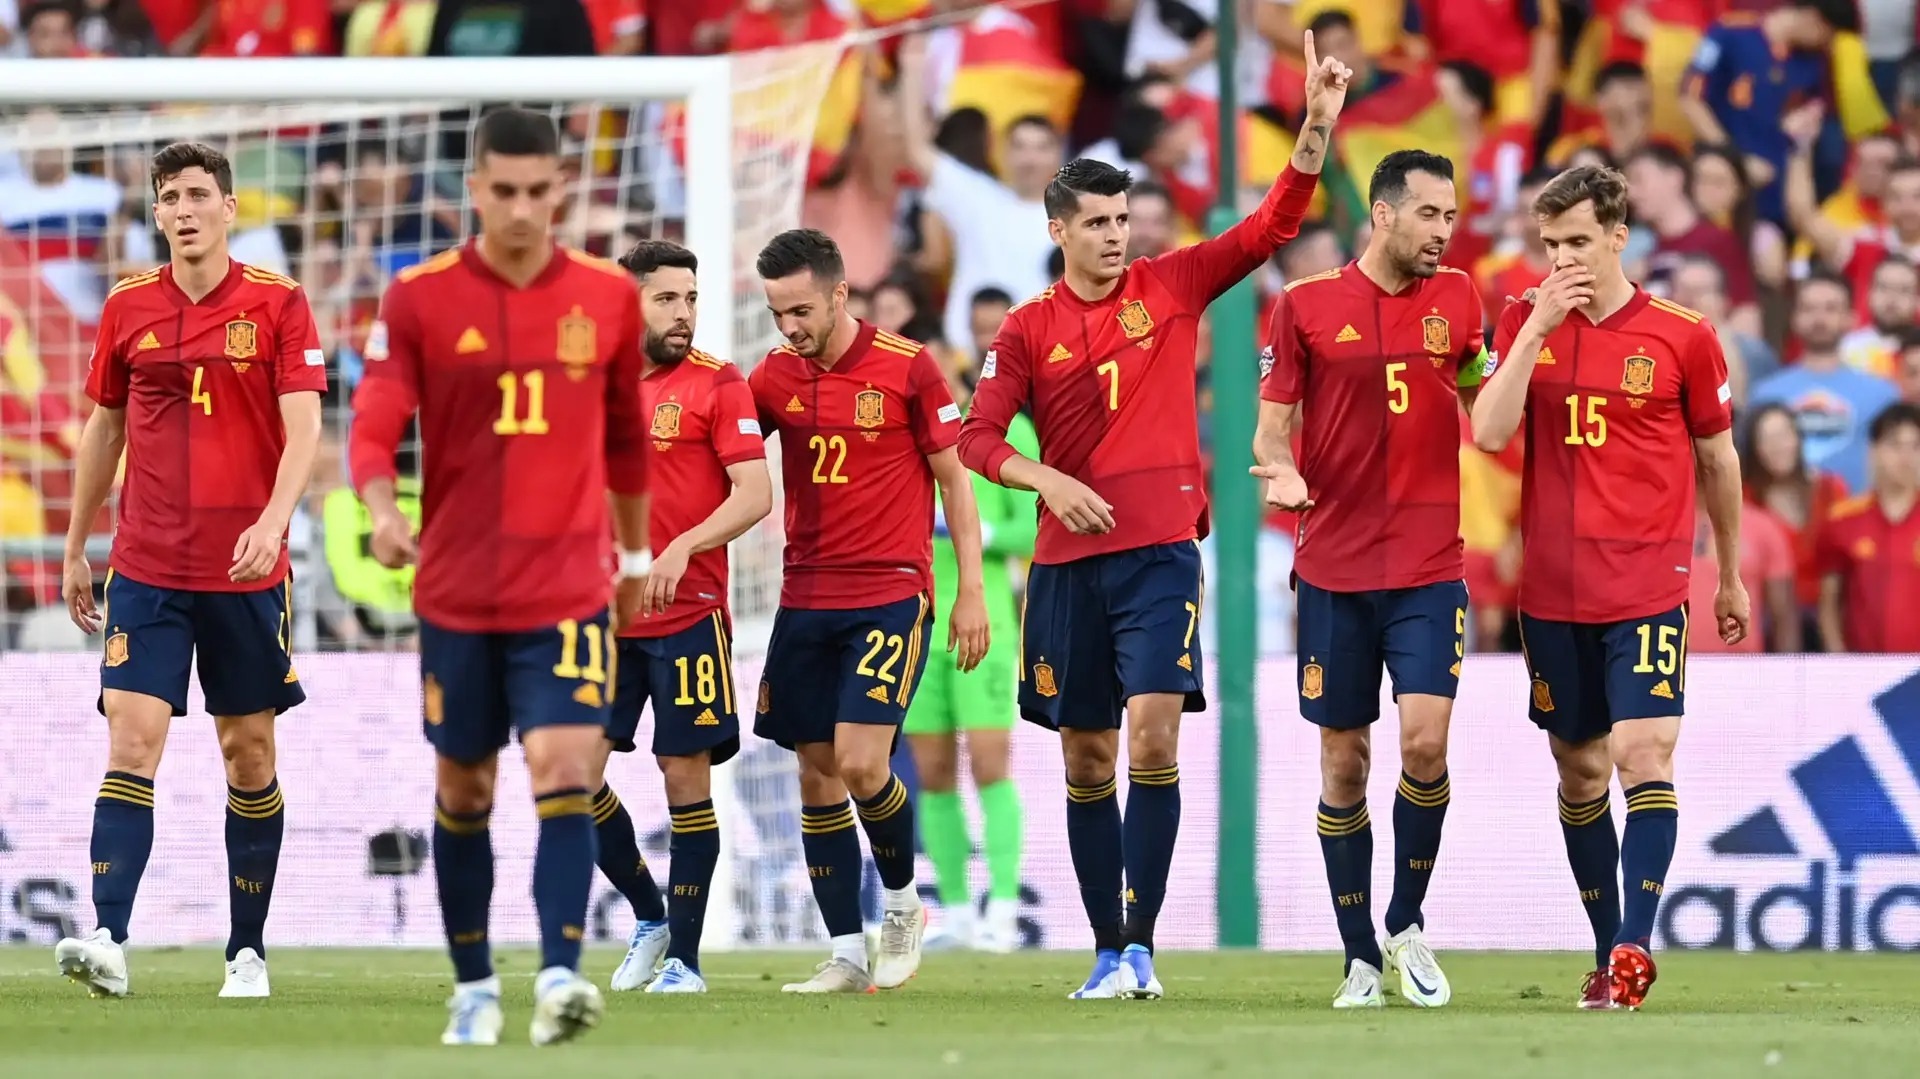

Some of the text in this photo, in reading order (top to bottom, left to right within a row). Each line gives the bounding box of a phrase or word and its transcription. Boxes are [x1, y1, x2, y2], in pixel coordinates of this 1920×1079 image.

[191, 366, 212, 416] 4
[493, 369, 549, 435] 11
[1097, 360, 1119, 411] 7
[1385, 362, 1409, 415] 5
[1564, 394, 1607, 447] 15
[809, 435, 849, 484] 22
[1183, 601, 1197, 649] 7
[1633, 624, 1678, 676] 15
[553, 618, 606, 684] 11
[856, 629, 904, 684] 22
[675, 654, 716, 706] 18
[91, 862, 111, 875] FEF
[235, 875, 264, 894] RFEF
[674, 884, 700, 897] RFEF
[1642, 879, 1664, 897] RFE
[1337, 891, 1366, 907] RFEF
